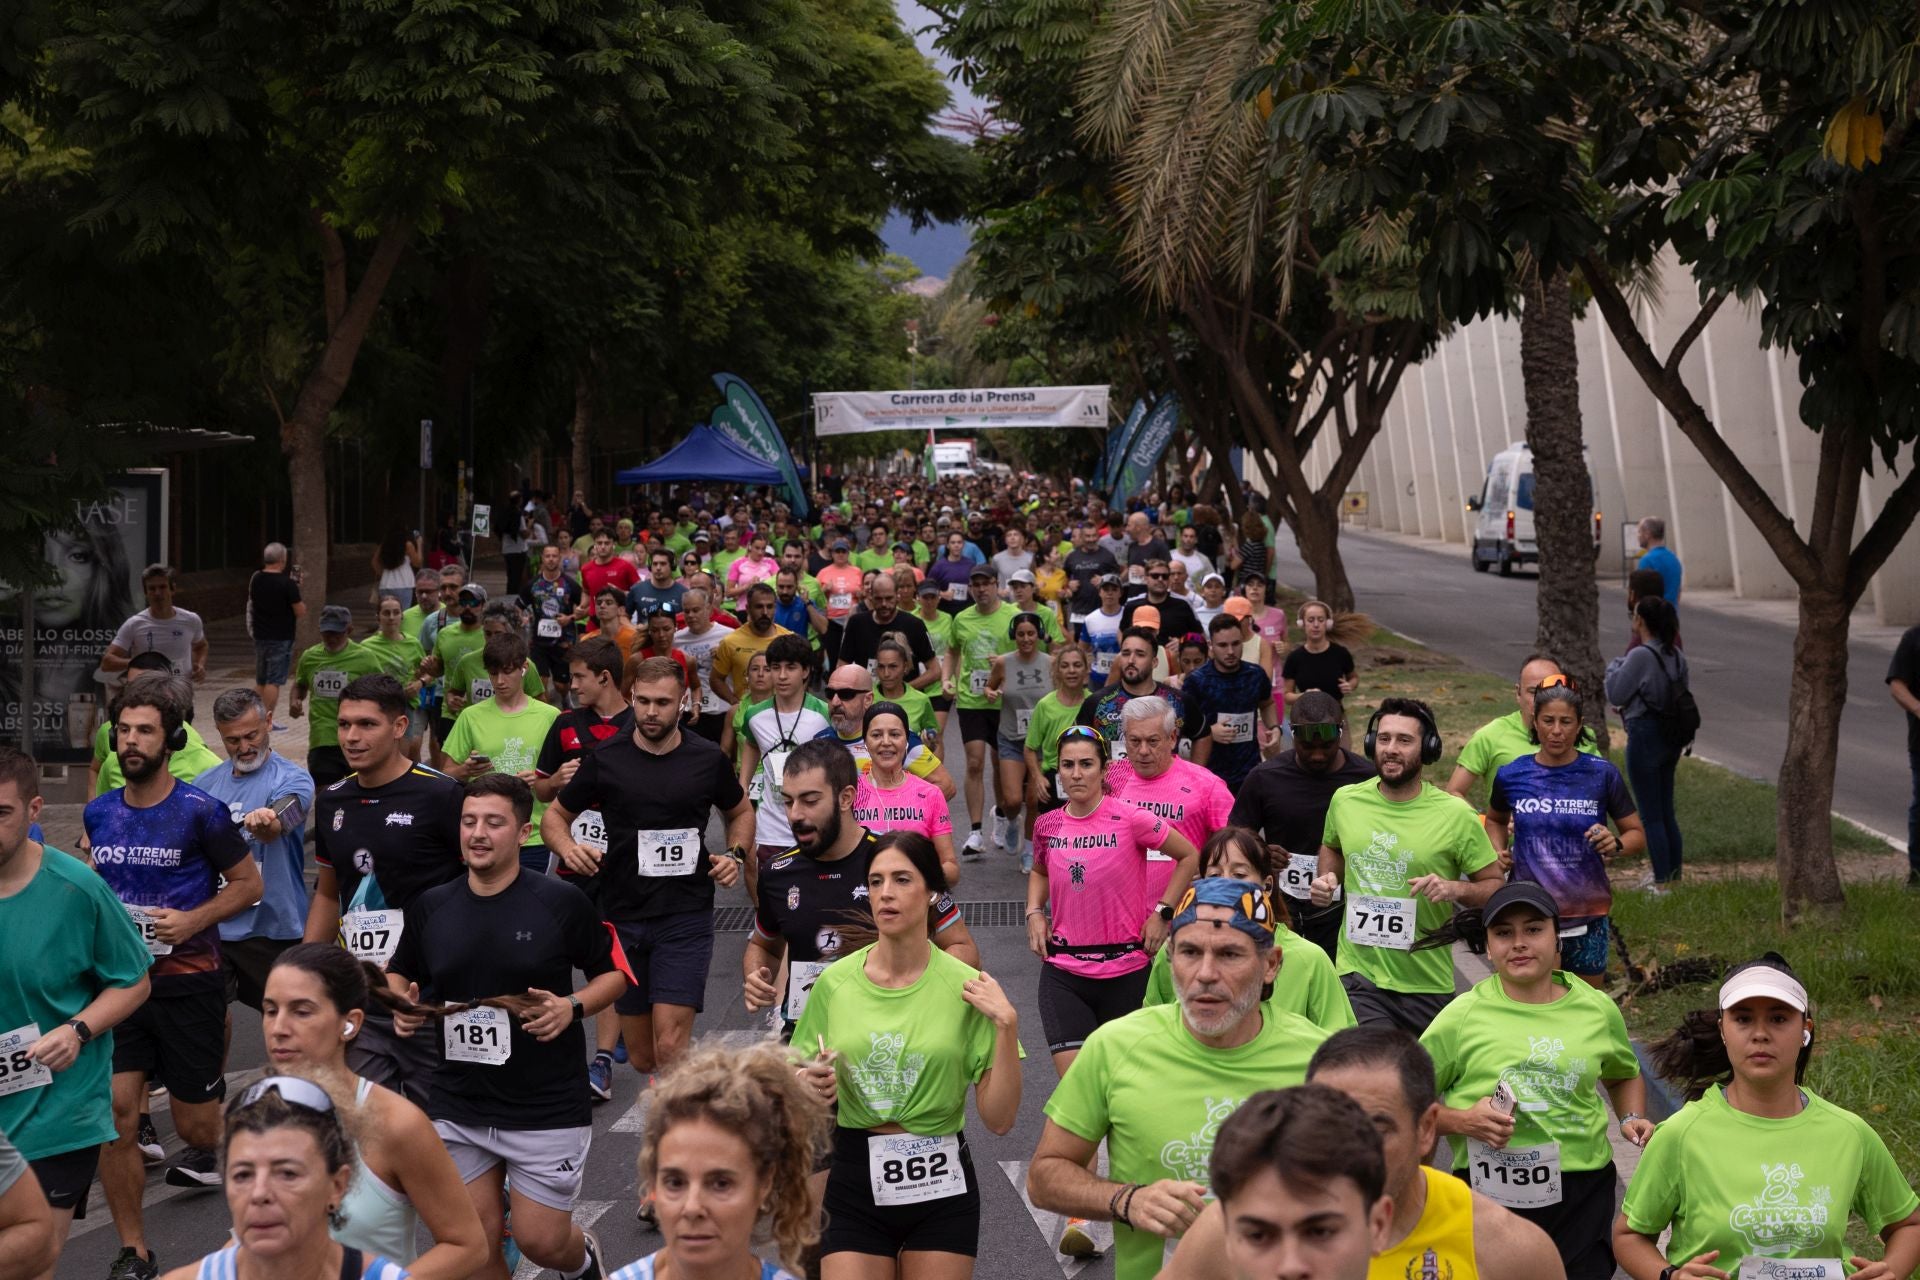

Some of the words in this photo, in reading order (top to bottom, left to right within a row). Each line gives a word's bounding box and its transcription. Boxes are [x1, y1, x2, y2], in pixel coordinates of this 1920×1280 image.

[891, 394, 945, 405] Carrera
[948, 392, 966, 404] de
[970, 392, 984, 403] la
[987, 391, 1036, 403] Prensa
[987, 405, 1018, 414] Libertad
[1133, 420, 1172, 467] Unicaja
[317, 679, 342, 690] 410
[475, 687, 496, 698] 40
[1554, 798, 1599, 810] XTREME
[1554, 806, 1598, 817] TRIATHLON
[884, 806, 924, 822] MEDULA
[1072, 832, 1118, 849] MEDULA
[127, 856, 181, 867] TRIATHLON
[128, 846, 182, 860] XTREME
[655, 845, 684, 862] 19
[1355, 911, 1404, 934] 716
[351, 929, 390, 951] 407
[453, 1023, 498, 1047] 181
[882, 1152, 949, 1184] 862
[1476, 1161, 1551, 1186] 1130
[1732, 1204, 1813, 1228] Carrera
[1747, 1222, 1819, 1240] Prensa
